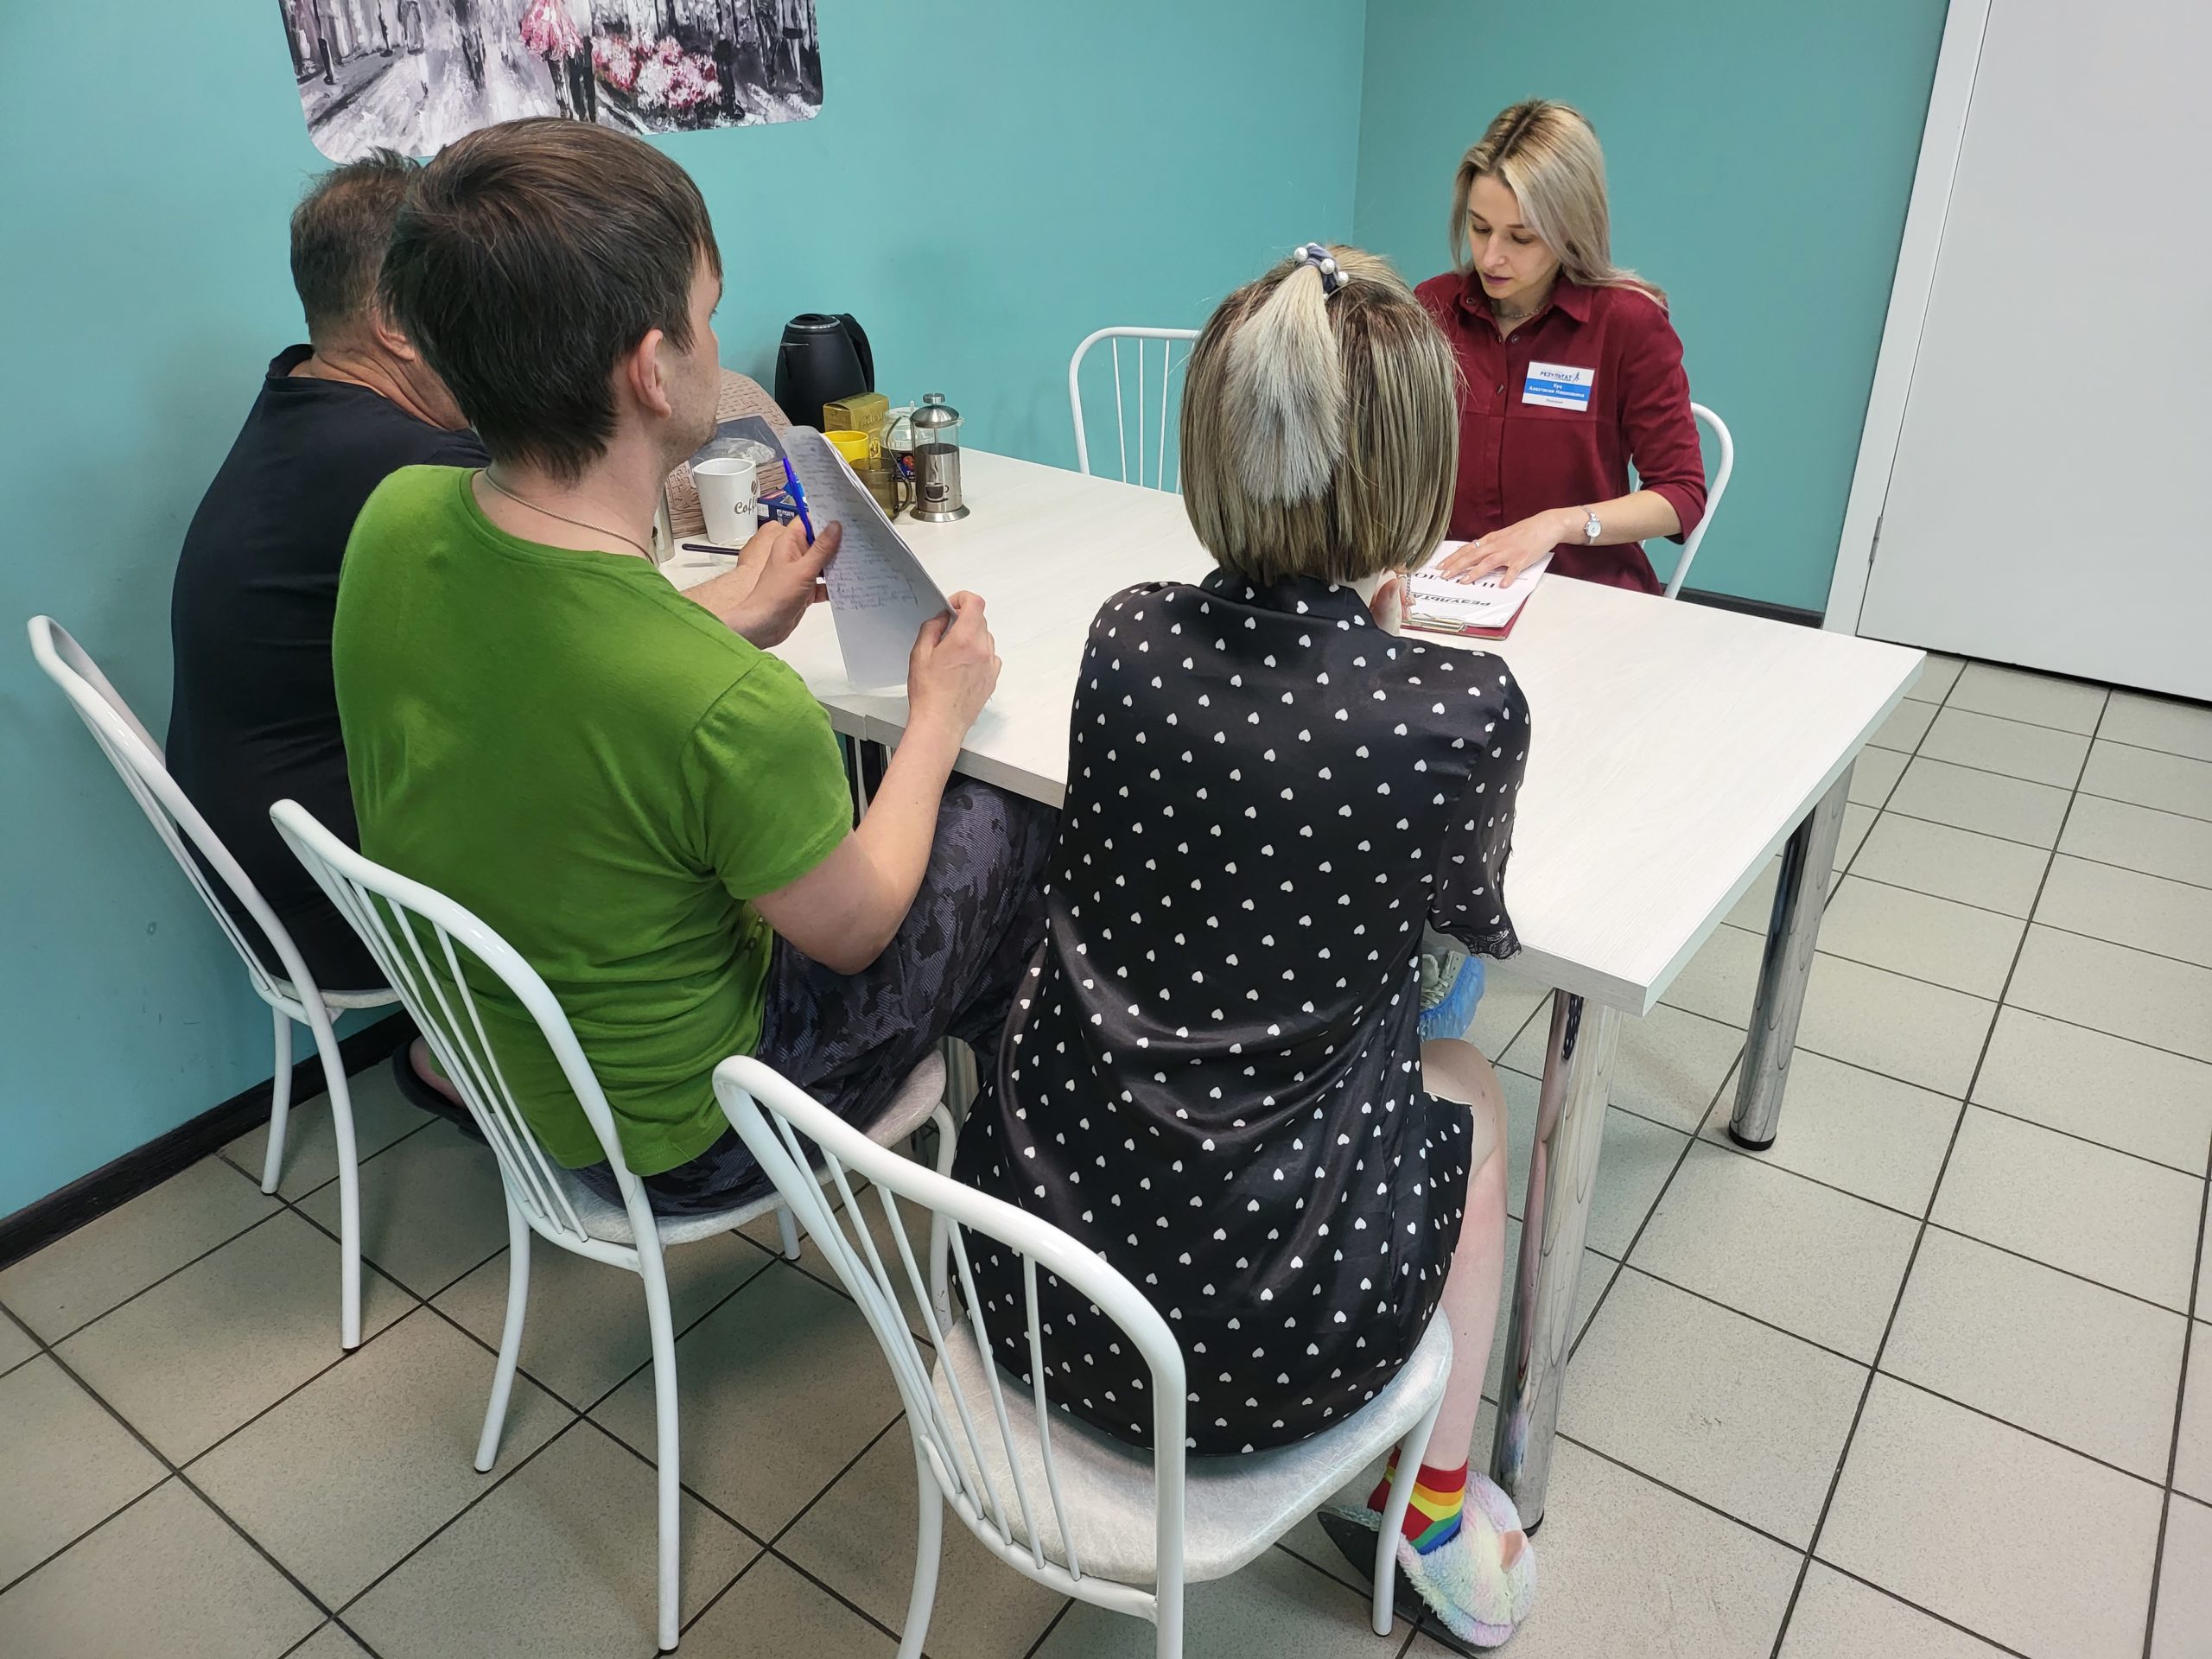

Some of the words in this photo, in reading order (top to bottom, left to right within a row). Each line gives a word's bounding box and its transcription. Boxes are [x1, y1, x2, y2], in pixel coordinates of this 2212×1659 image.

[1540, 372, 1572, 380] РЕЗУЛЬТАТ
[734, 497, 758, 515] Coff
[1413, 594, 1491, 607] РЕЗУЛЬТА
